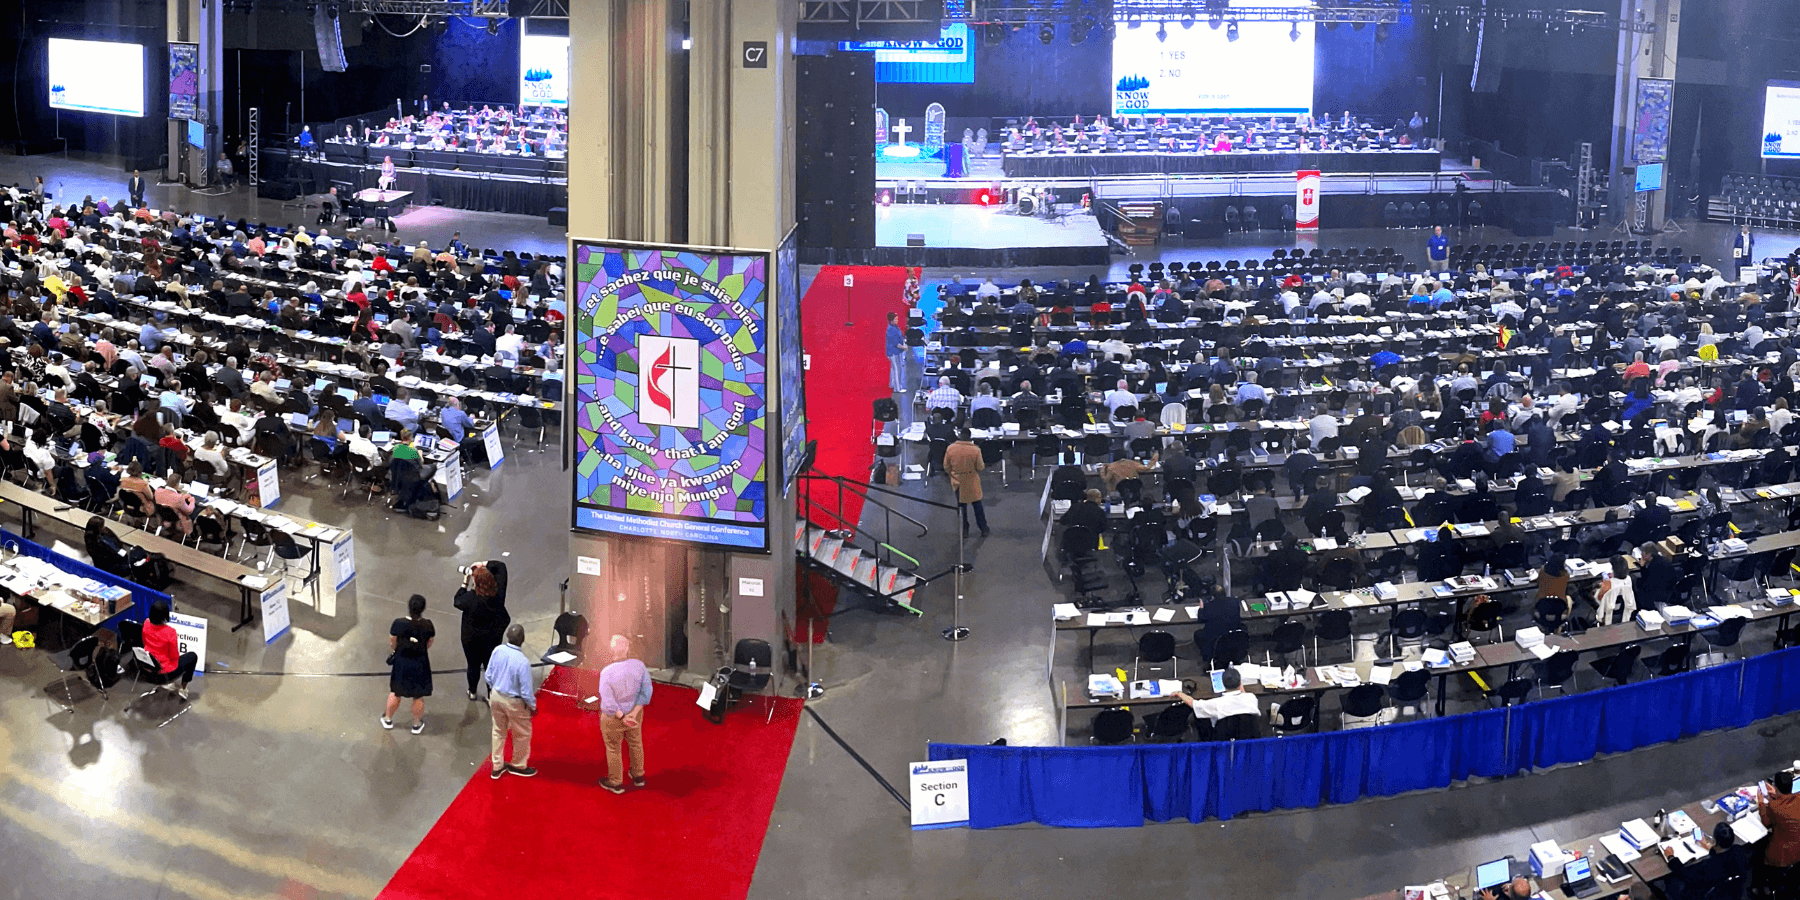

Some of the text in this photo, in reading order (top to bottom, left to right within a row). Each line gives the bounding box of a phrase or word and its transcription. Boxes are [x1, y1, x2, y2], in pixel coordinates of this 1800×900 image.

[937, 38, 964, 48] GOD
[746, 47, 764, 62] C7
[1169, 51, 1186, 60] YES
[1169, 69, 1182, 78] NO
[1126, 100, 1150, 108] GOD
[600, 271, 650, 297] sachez
[653, 270, 682, 281] que
[683, 272, 698, 286] je
[701, 282, 732, 304] suis
[732, 302, 759, 334] Dieu
[606, 304, 640, 335] sabei
[644, 302, 671, 314] que
[675, 304, 694, 316] eu
[696, 312, 722, 334] sou
[720, 333, 744, 372] Deus
[619, 428, 658, 456] know
[665, 447, 698, 459] that
[698, 444, 707, 454] I
[708, 431, 730, 449] am
[726, 402, 745, 430] God
[624, 466, 656, 484] ujue
[660, 478, 678, 488] ya
[680, 460, 742, 487] kwamba
[612, 476, 728, 504] miye njo Mungu
[591, 510, 750, 536] The United Methodist Church General Conference
[686, 532, 718, 540] CAROLINA
[177, 633, 198, 642] ction
[180, 642, 188, 653] B
[921, 782, 958, 791] Section
[934, 794, 945, 806] C
